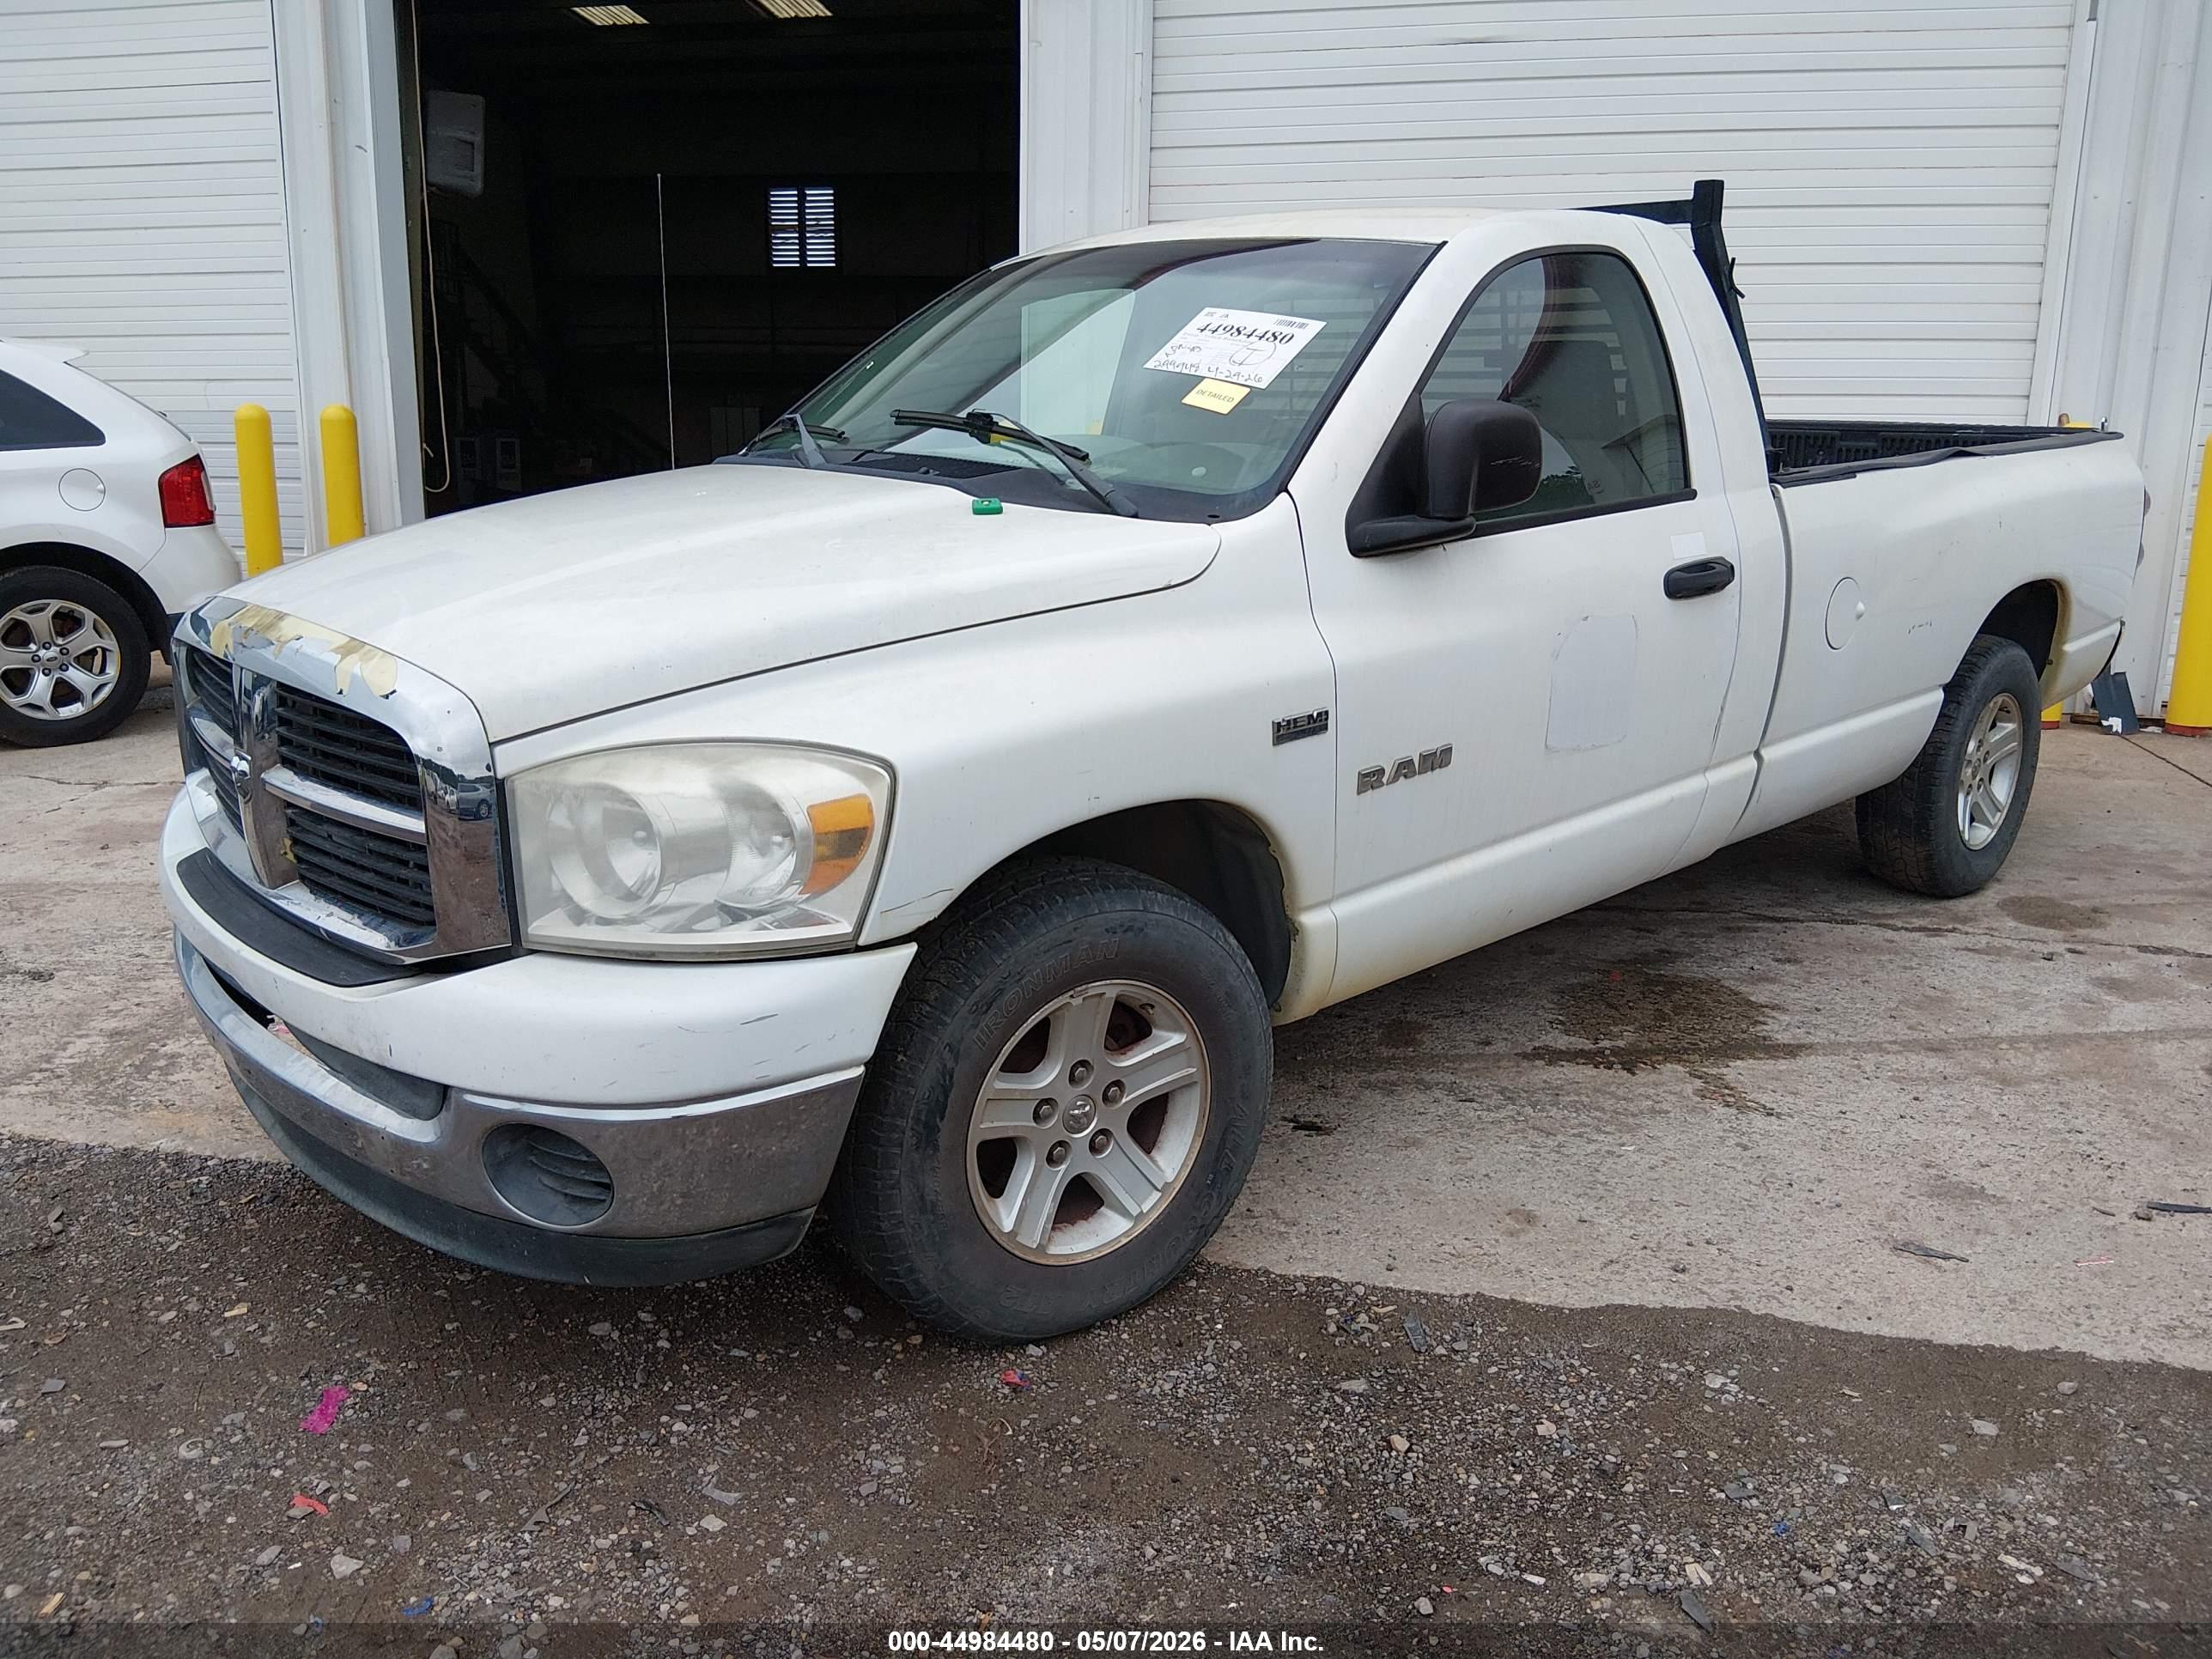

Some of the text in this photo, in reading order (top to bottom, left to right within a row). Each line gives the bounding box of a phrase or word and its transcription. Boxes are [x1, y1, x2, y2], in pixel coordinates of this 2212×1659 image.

[1196, 322, 1295, 345] 44984480
[1196, 389, 1235, 404] DETAILED
[1356, 743, 1453, 795] RAM
[972, 938, 1121, 1051] IRONMAN
